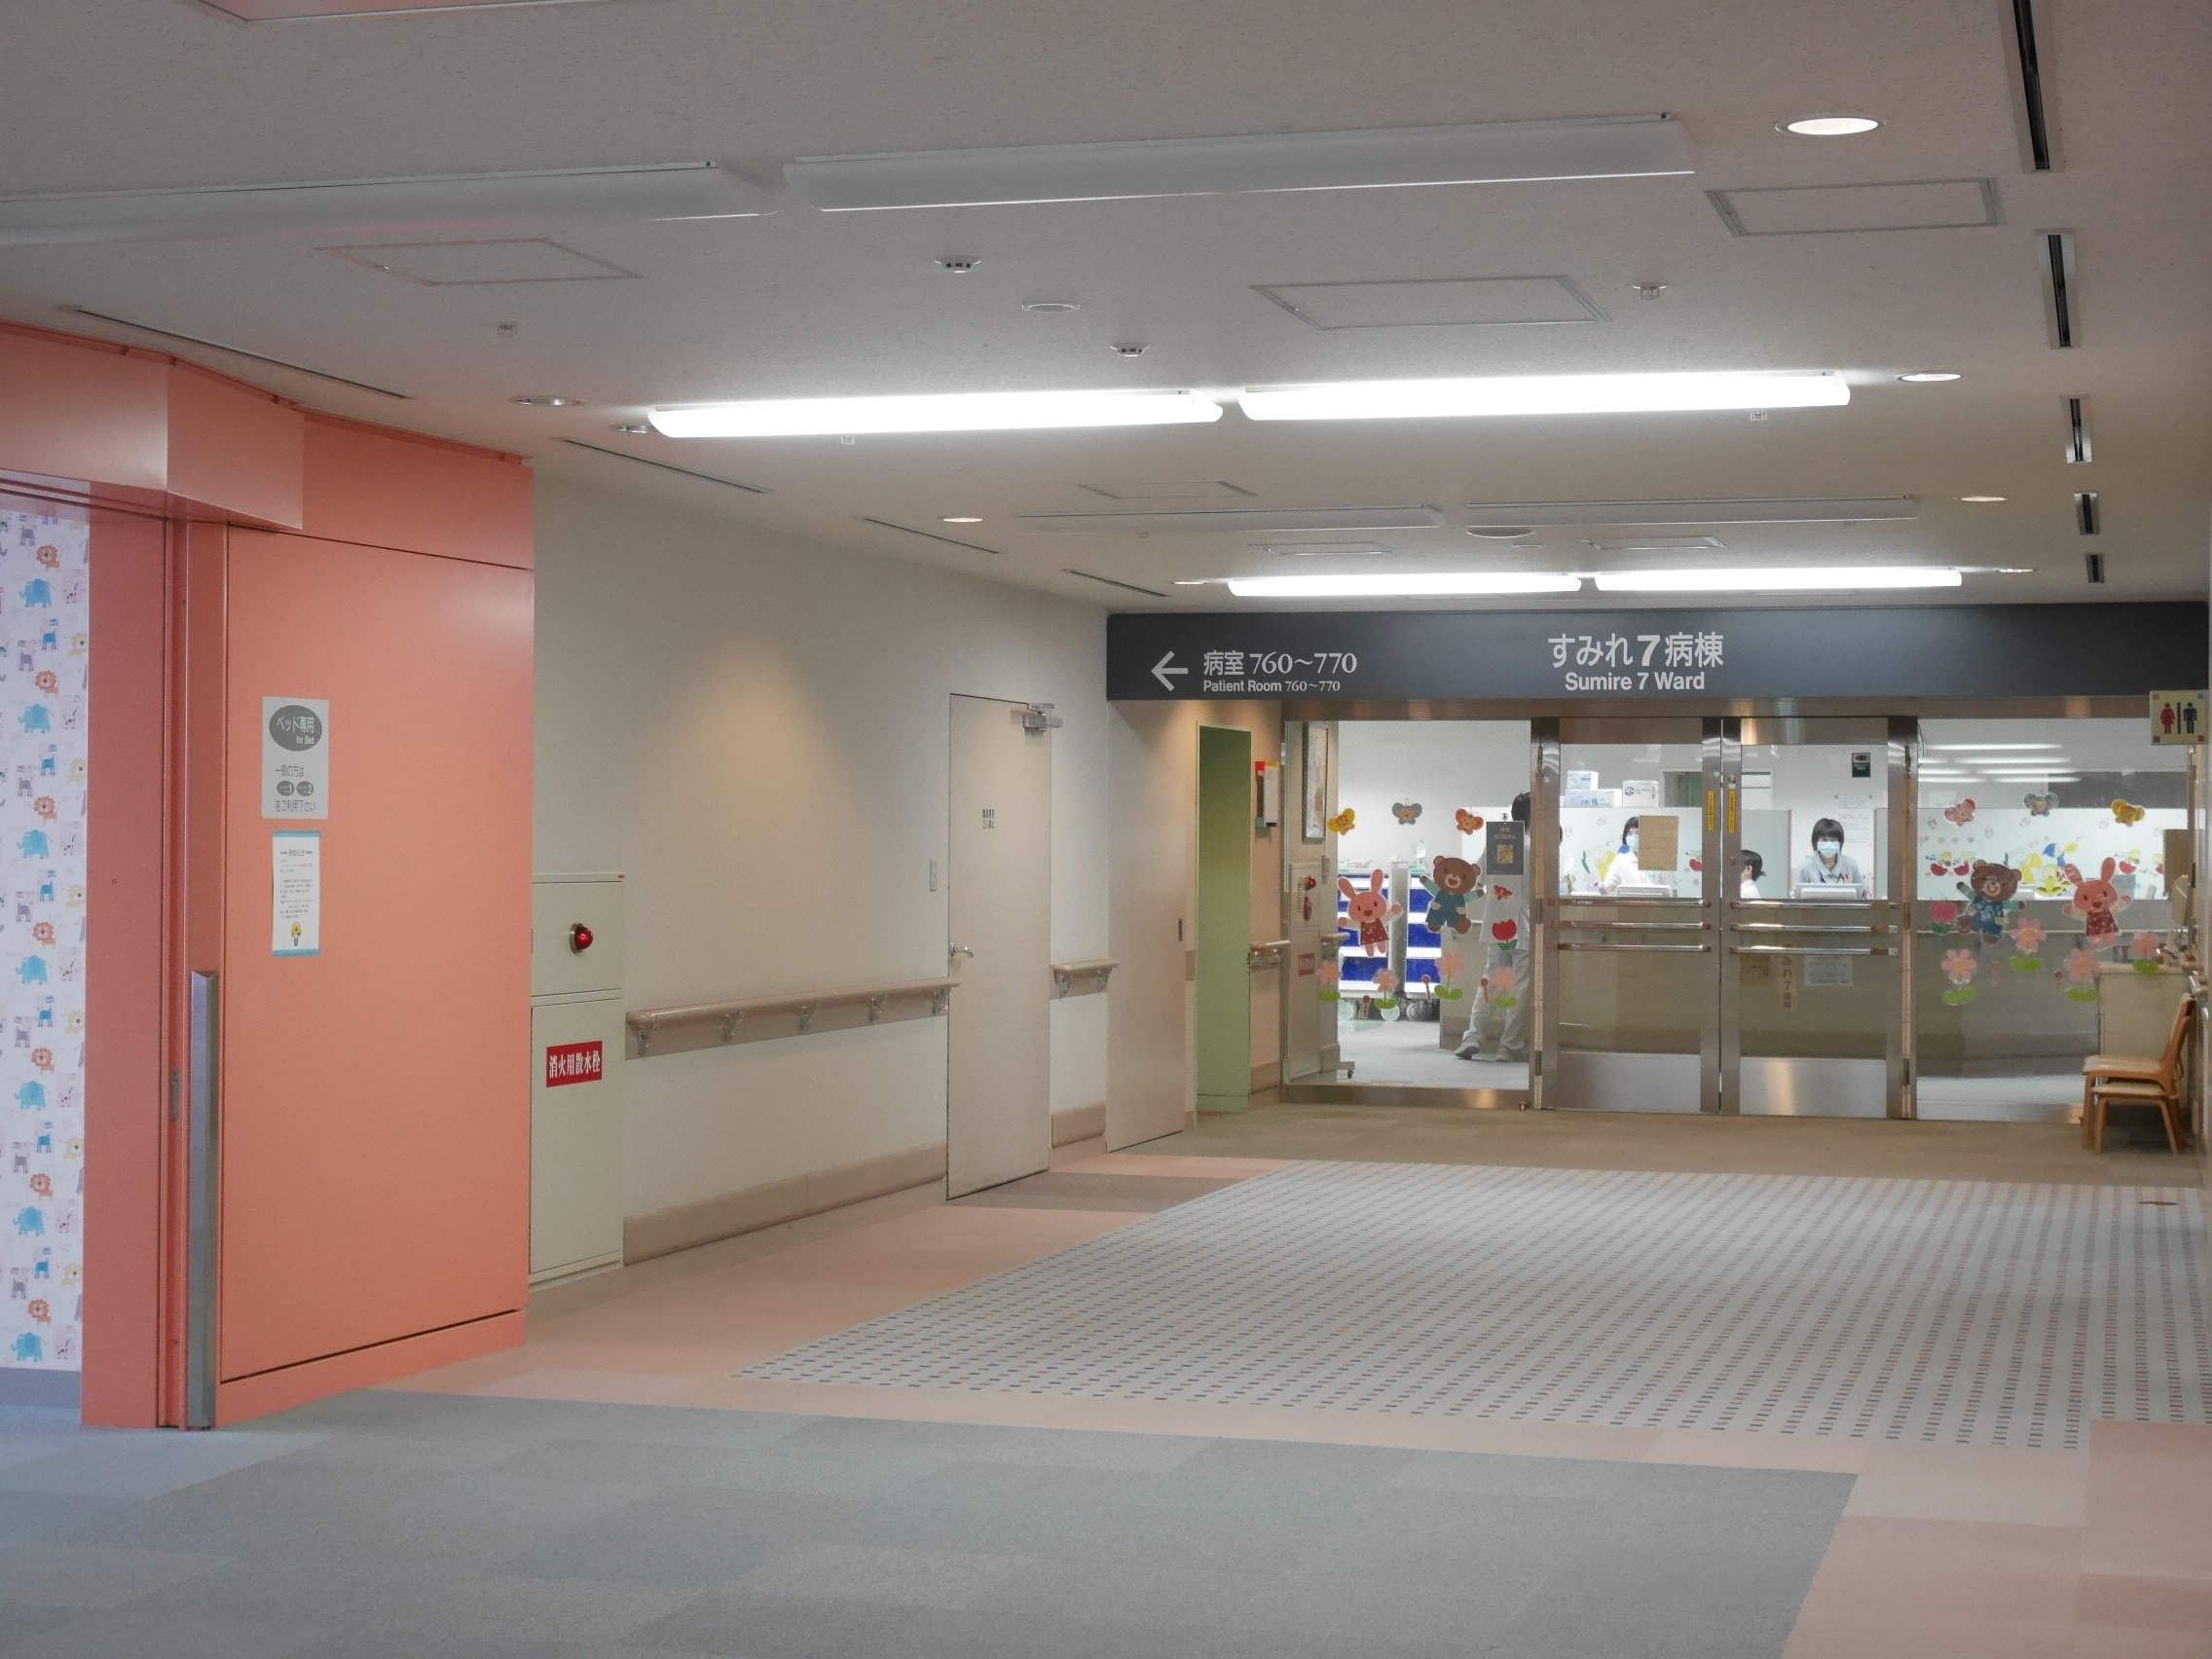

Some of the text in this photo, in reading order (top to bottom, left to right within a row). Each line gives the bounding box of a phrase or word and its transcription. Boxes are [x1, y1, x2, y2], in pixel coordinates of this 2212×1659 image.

[1203, 650, 1245, 676] 病室
[1548, 632, 1724, 668] すみれ7病棟
[1203, 680, 1245, 692] Patient
[1247, 681, 1282, 692] Room
[1565, 672, 1705, 691] Sumire 7 Ward
[548, 1050, 601, 1079] 消火用散水栓
